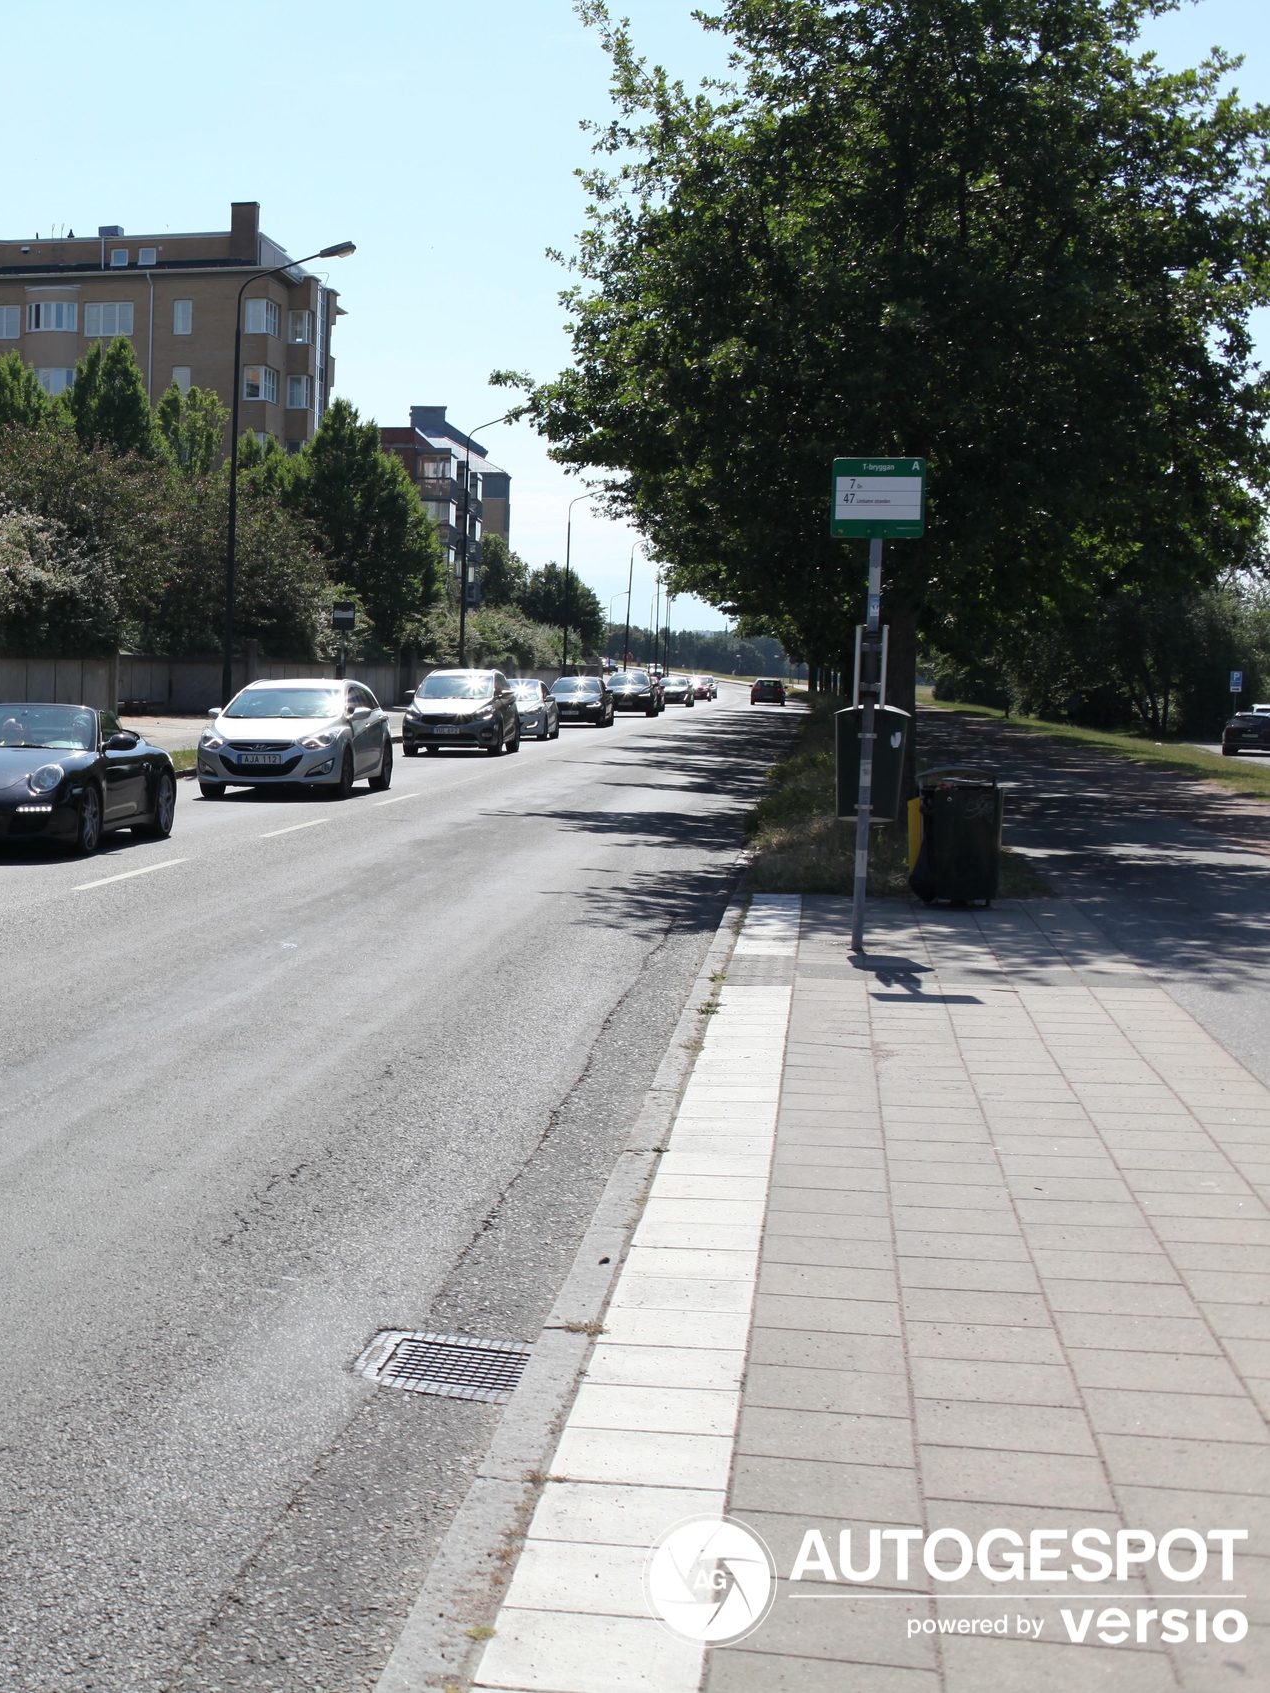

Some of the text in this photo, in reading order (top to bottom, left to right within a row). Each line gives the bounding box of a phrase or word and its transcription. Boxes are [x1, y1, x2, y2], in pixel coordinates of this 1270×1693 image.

[863, 463, 895, 471] T-bryggan
[911, 461, 920, 470] A
[850, 478, 856, 489] 7
[843, 493, 856, 503] 47
[1233, 672, 1240, 681] P
[244, 755, 277, 763] AJA 112
